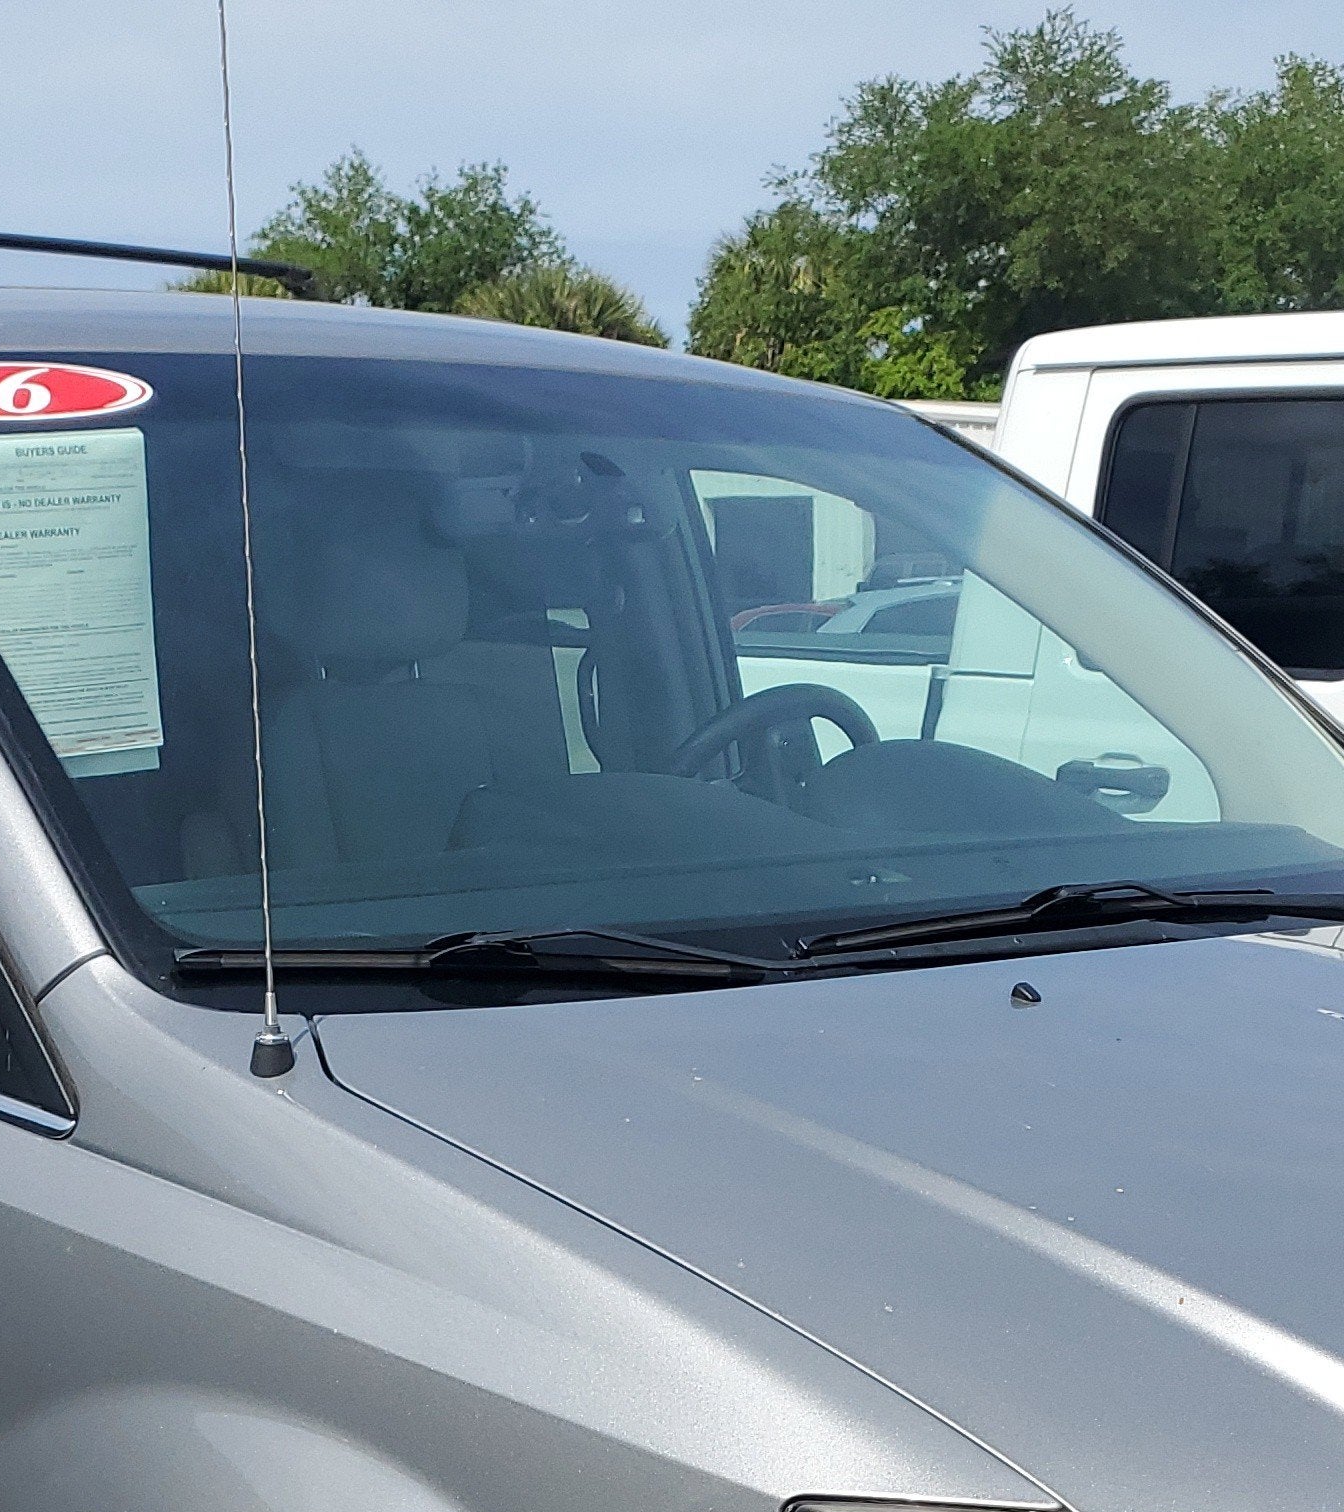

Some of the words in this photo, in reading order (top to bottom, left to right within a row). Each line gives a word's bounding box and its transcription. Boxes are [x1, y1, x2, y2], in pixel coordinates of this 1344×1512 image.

[15, 446, 55, 457] BUYERS
[57, 444, 88, 455] GUIDE
[19, 498, 32, 508] NO
[34, 496, 71, 507] DEALER
[73, 494, 122, 505] WARRANTY
[30, 527, 80, 538] WARRANTY
